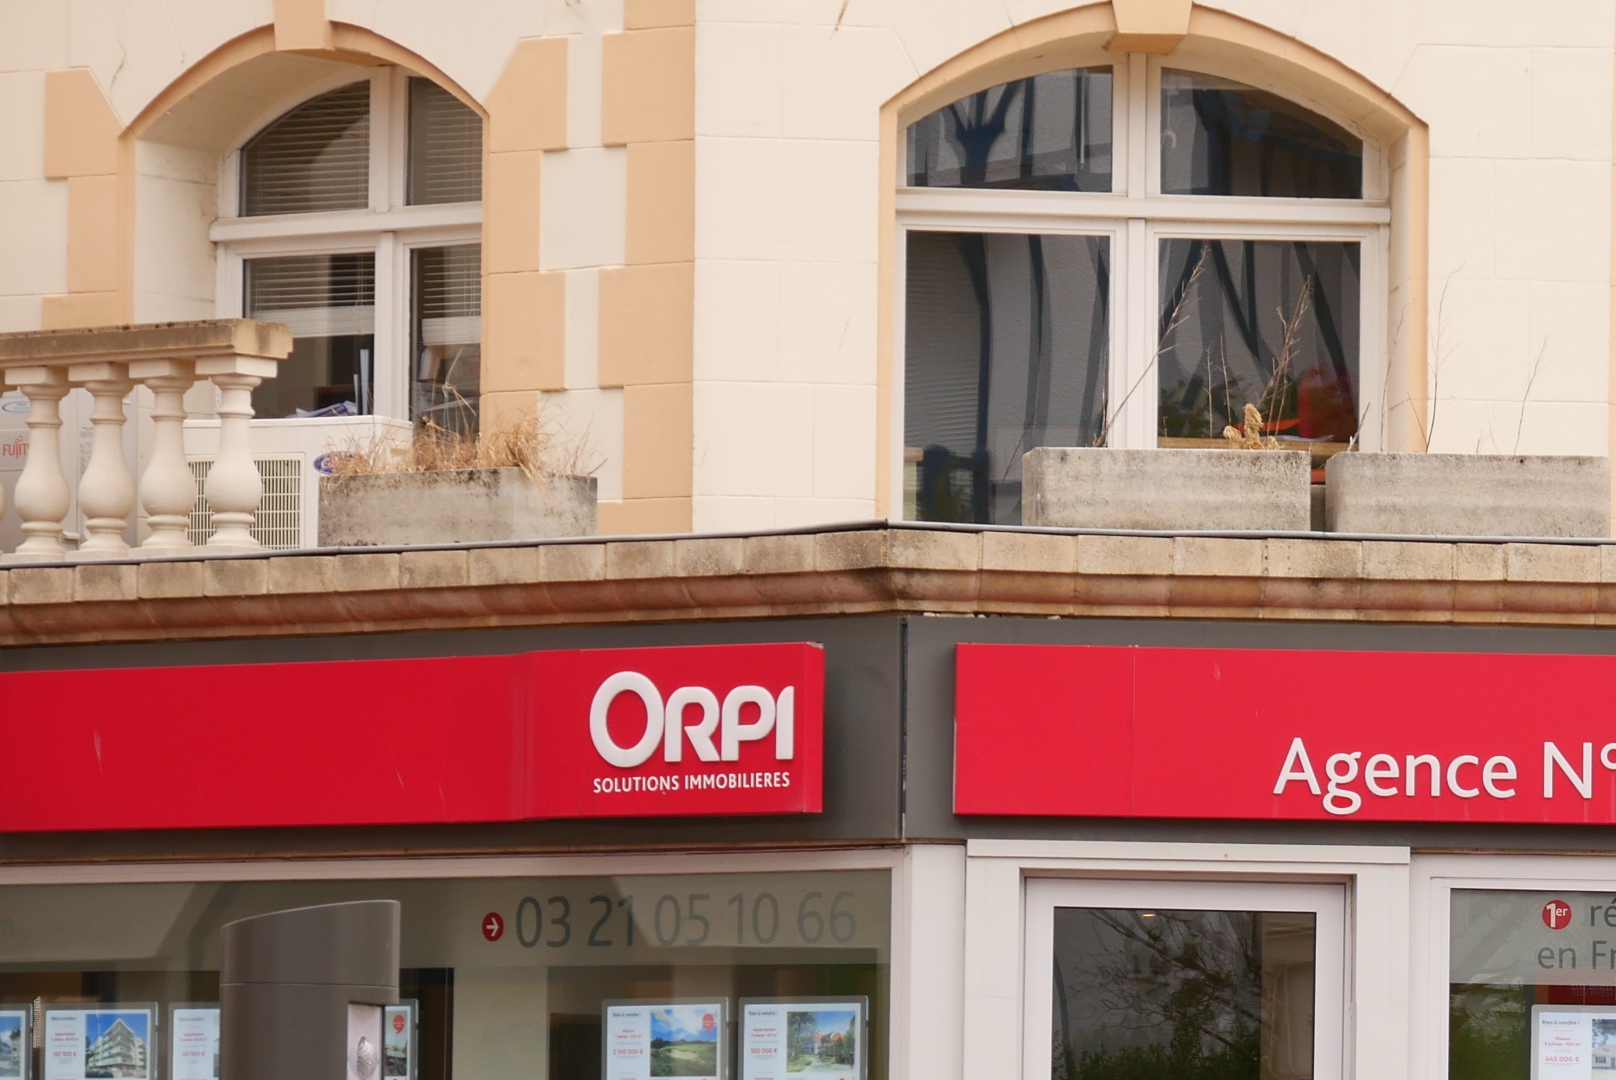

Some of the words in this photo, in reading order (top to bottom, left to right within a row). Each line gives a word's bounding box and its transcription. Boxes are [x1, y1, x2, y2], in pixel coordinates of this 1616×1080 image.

[2, 438, 30, 459] FUJIT
[589, 671, 795, 768] ORPI
[593, 773, 680, 793] SOLUTIONS
[684, 771, 791, 791] IMMOBILIERES
[1272, 738, 1517, 815] Agence
[516, 895, 571, 949] 03
[588, 894, 634, 948] 21
[655, 892, 710, 946] 05
[728, 890, 779, 945] 10
[799, 889, 857, 943] 66
[1537, 946, 1577, 970] en
